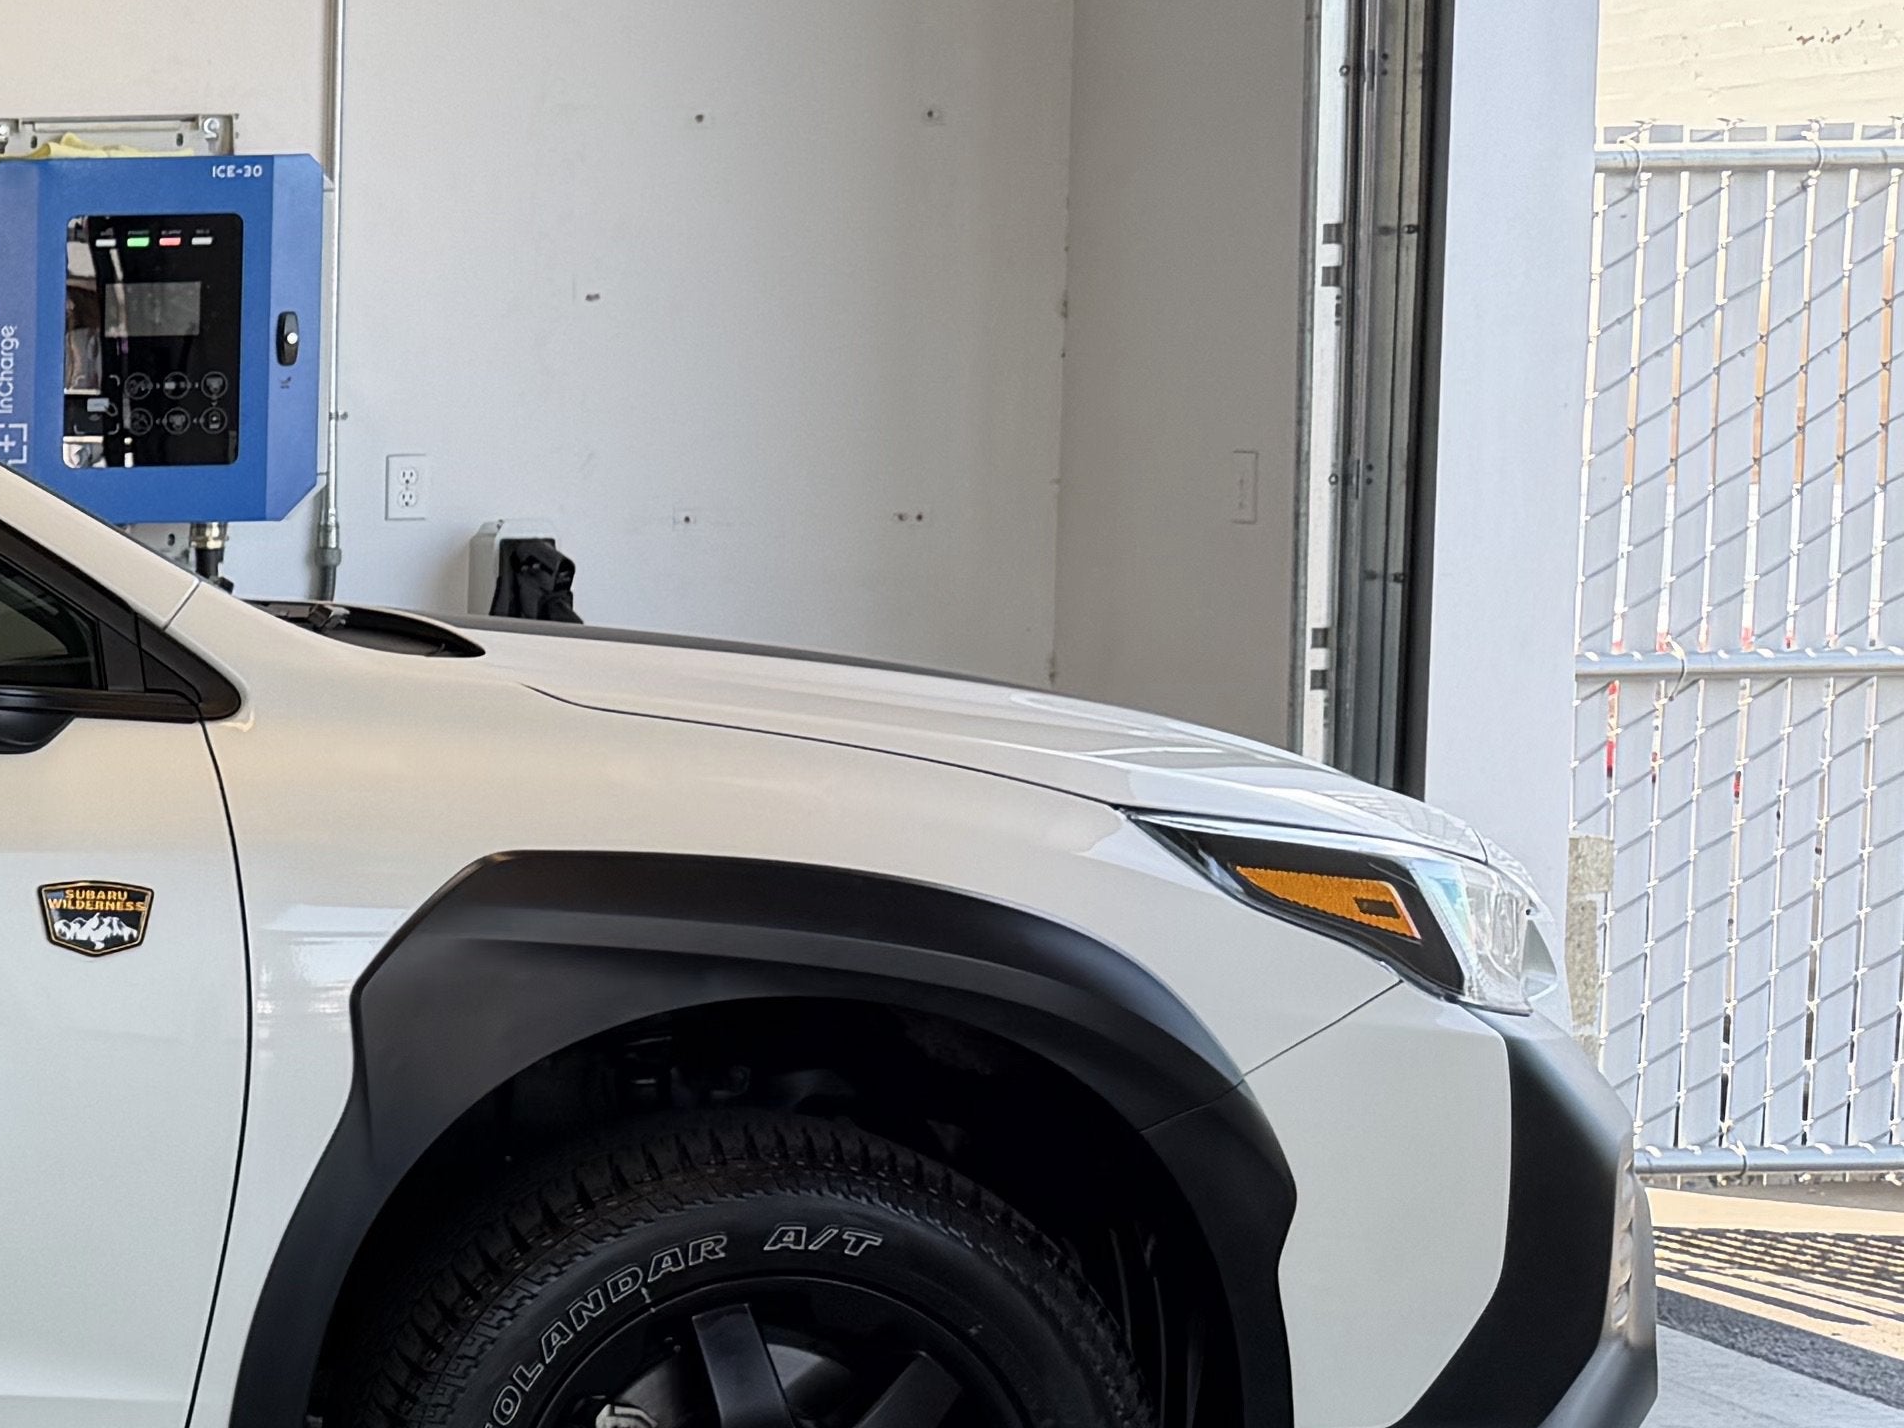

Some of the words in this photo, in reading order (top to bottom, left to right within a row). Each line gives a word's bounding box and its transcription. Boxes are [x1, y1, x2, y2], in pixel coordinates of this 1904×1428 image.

[212, 164, 263, 178] ICE-30
[64, 889, 128, 901] SUBARU
[47, 898, 147, 912] WILDERNESS
[763, 1225, 883, 1256] A/T
